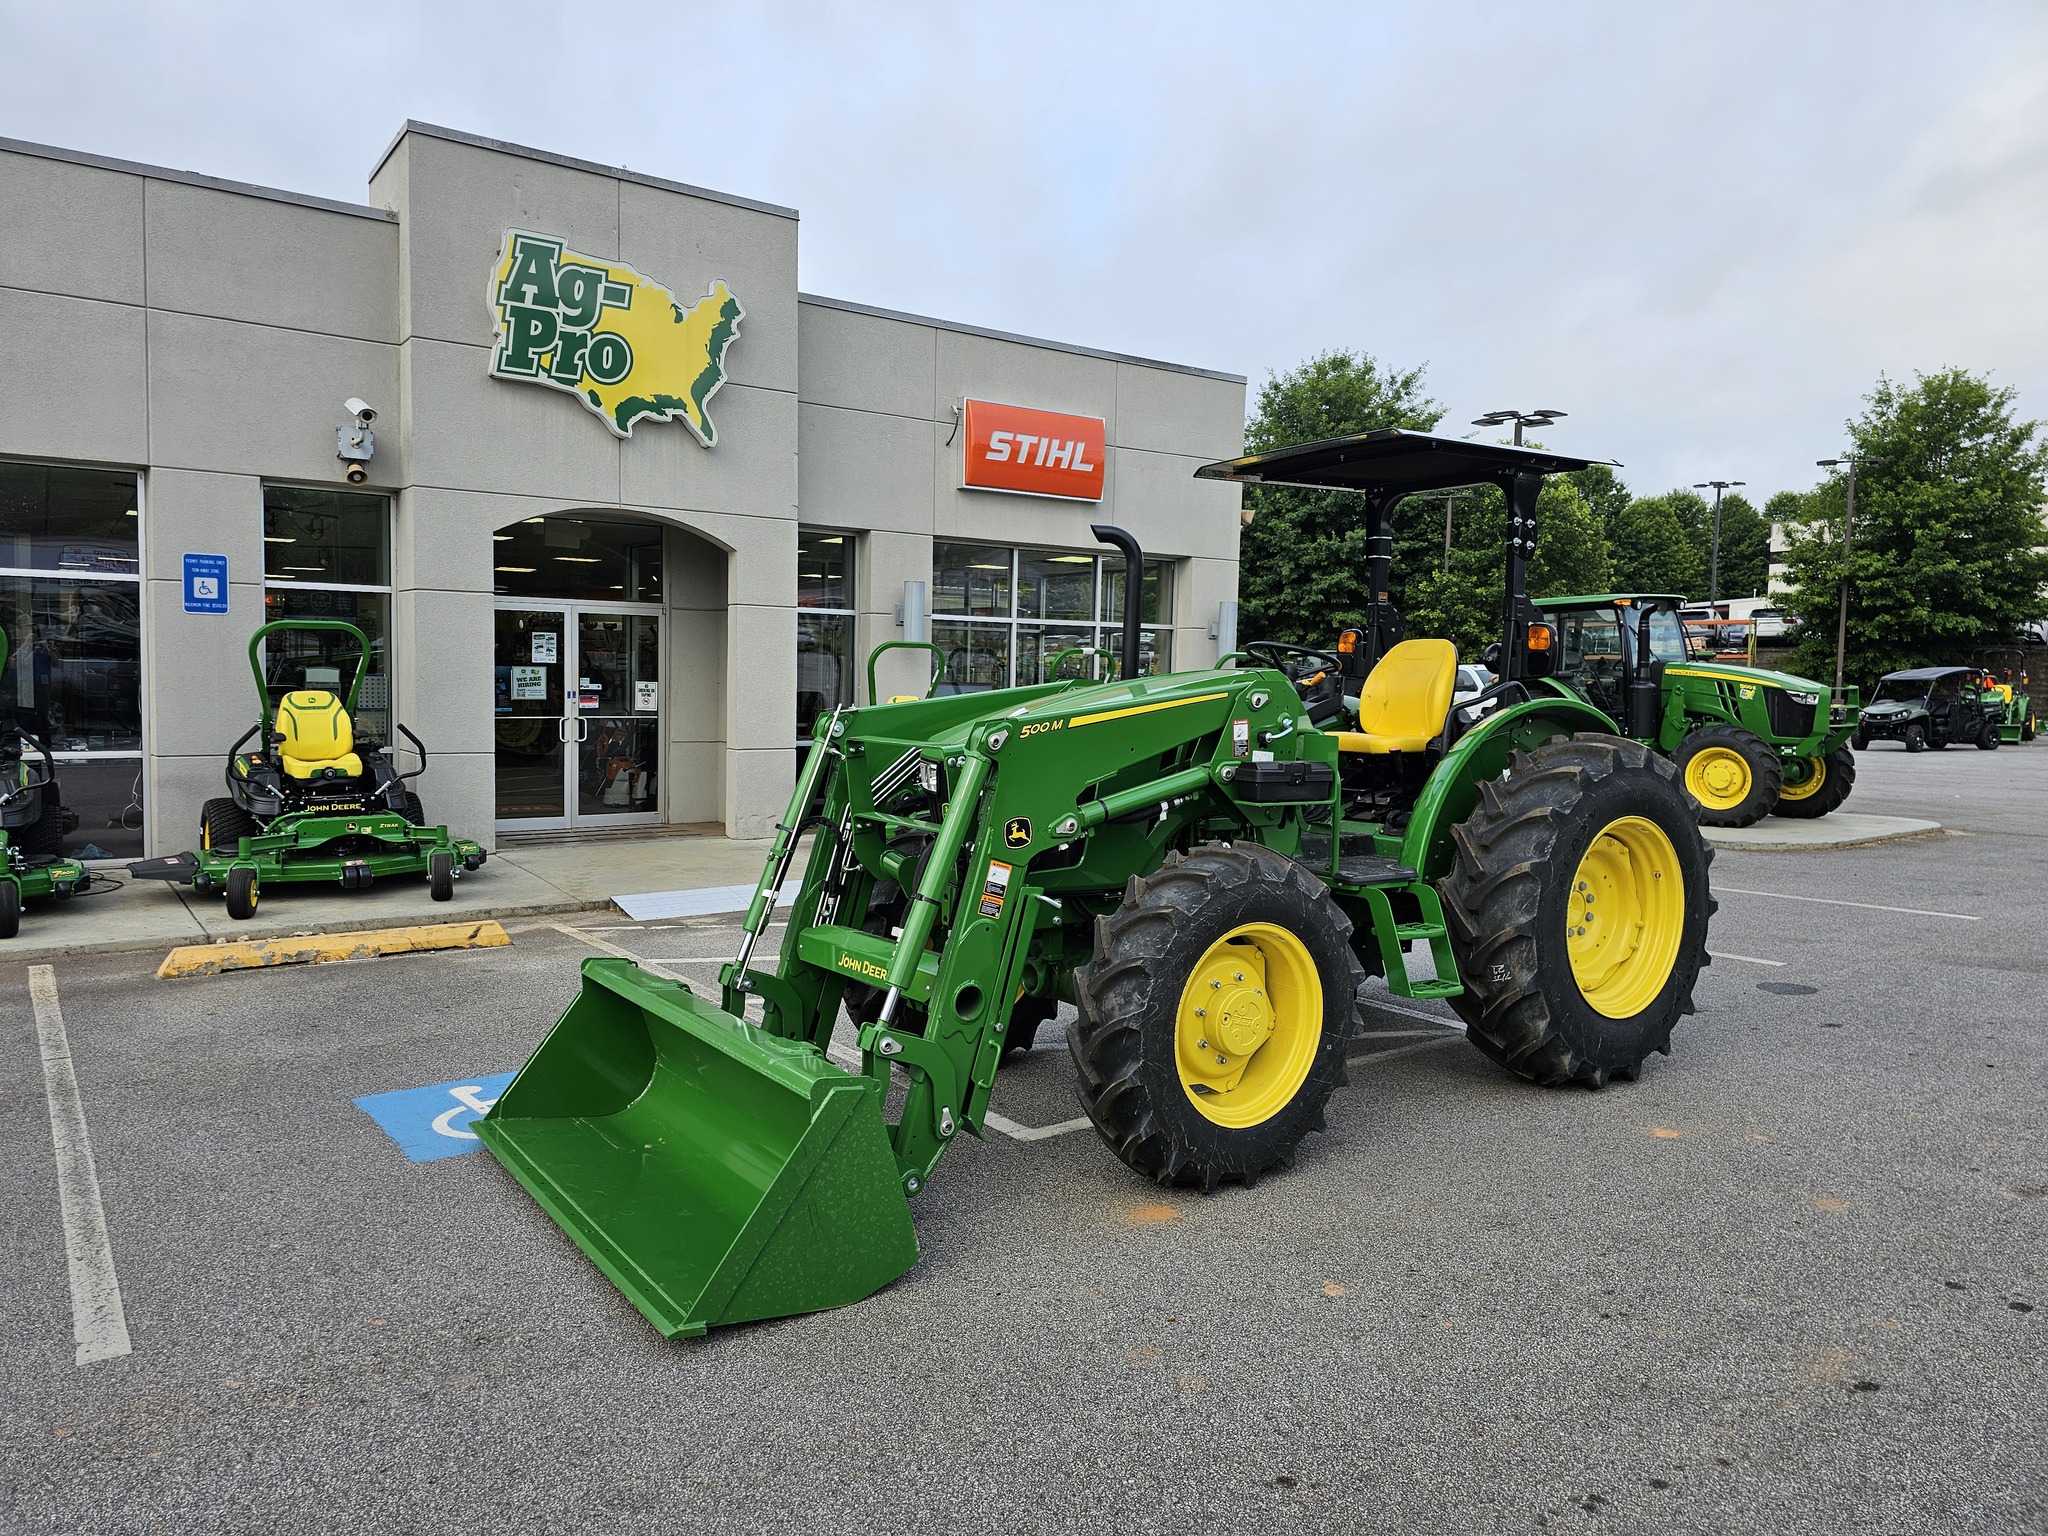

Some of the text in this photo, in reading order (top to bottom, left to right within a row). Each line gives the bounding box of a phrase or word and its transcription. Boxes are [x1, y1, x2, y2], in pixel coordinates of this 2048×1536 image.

[501, 236, 631, 328] Ag-
[501, 304, 632, 384] Pro
[985, 430, 1094, 472] STIHL
[1020, 719, 1064, 739] 500 M
[304, 803, 362, 812] JOHN DEERE
[838, 953, 889, 981] JOHN DEER
